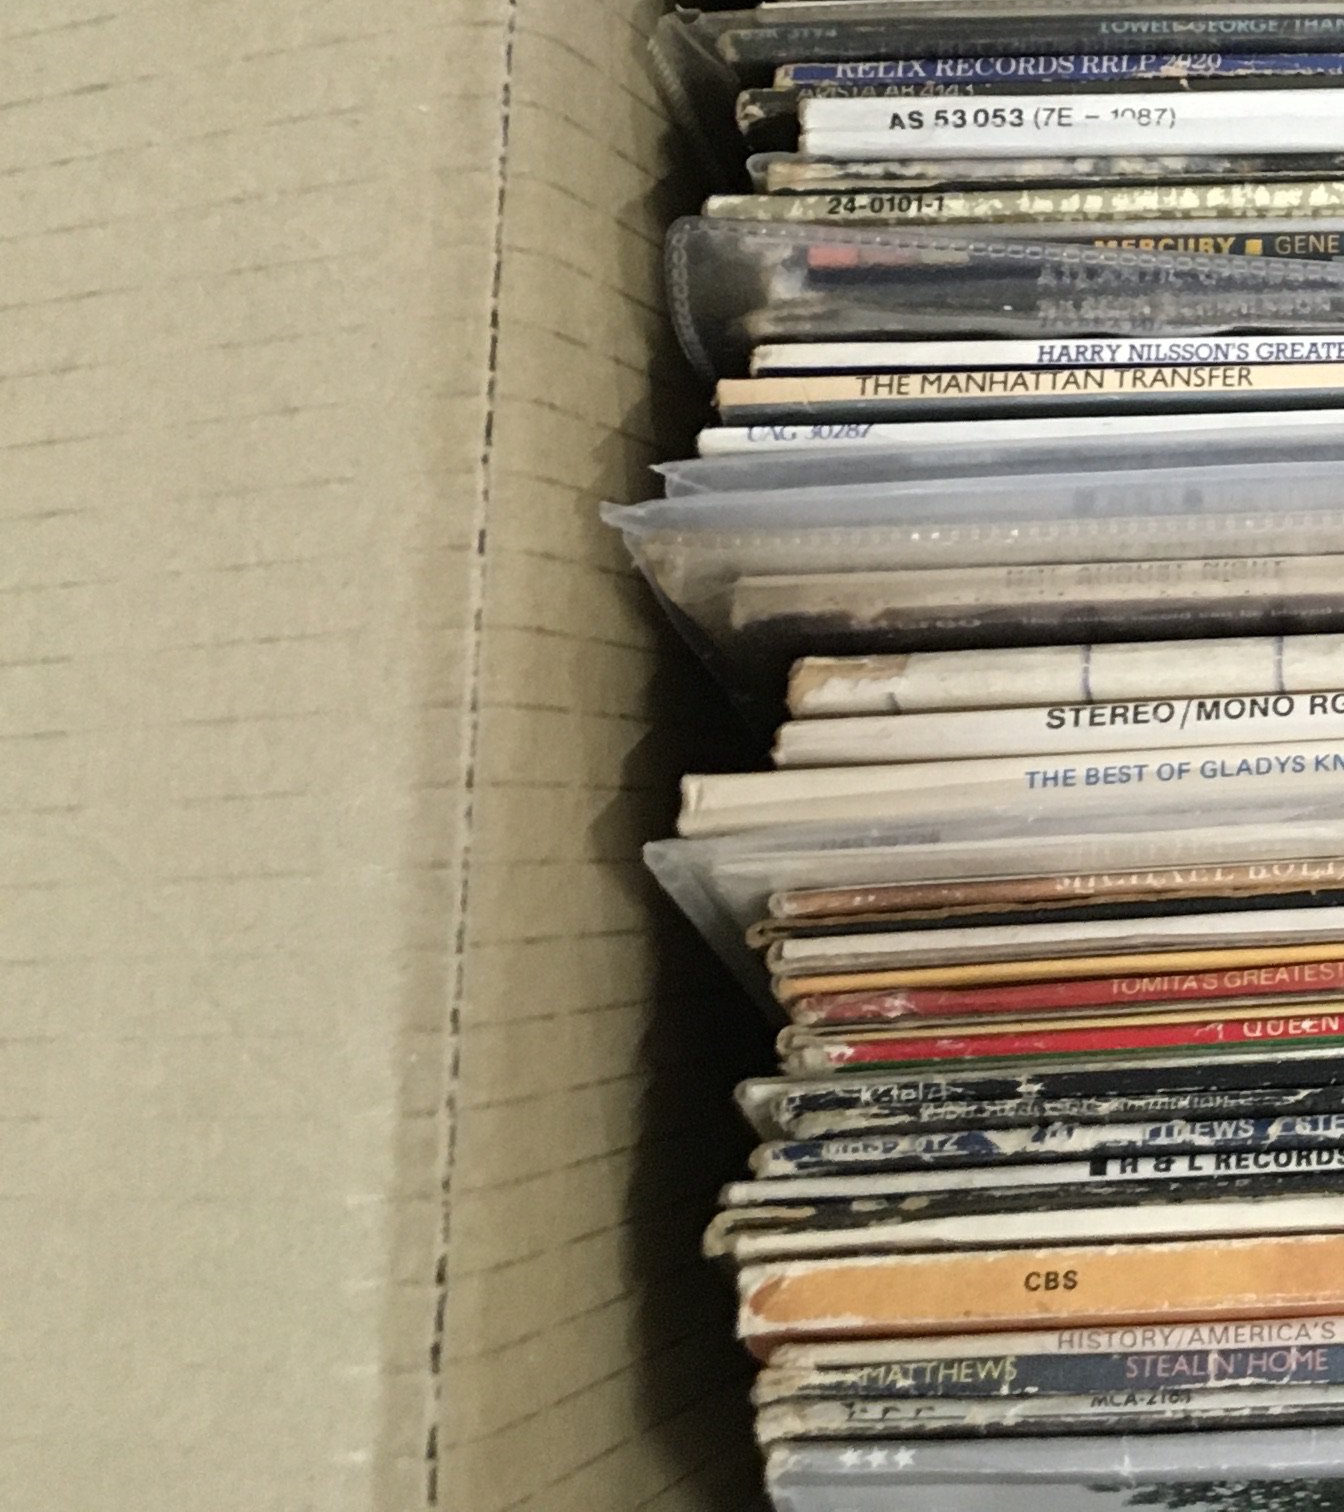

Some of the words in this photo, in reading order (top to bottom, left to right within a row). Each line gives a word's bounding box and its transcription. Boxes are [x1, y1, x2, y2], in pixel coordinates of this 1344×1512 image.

[1275, 235, 1344, 254] GENE
[1037, 343, 1122, 363] HARRY
[856, 375, 911, 396] THE
[920, 369, 1105, 393] MANHATTAN
[1113, 367, 1253, 388] TRANSFER
[1025, 770, 1078, 790] THE
[1085, 765, 1147, 787] BEST
[1156, 762, 1191, 782] OF
[1200, 755, 1306, 778] GLADYS
[1024, 1270, 1078, 1292] CBS
